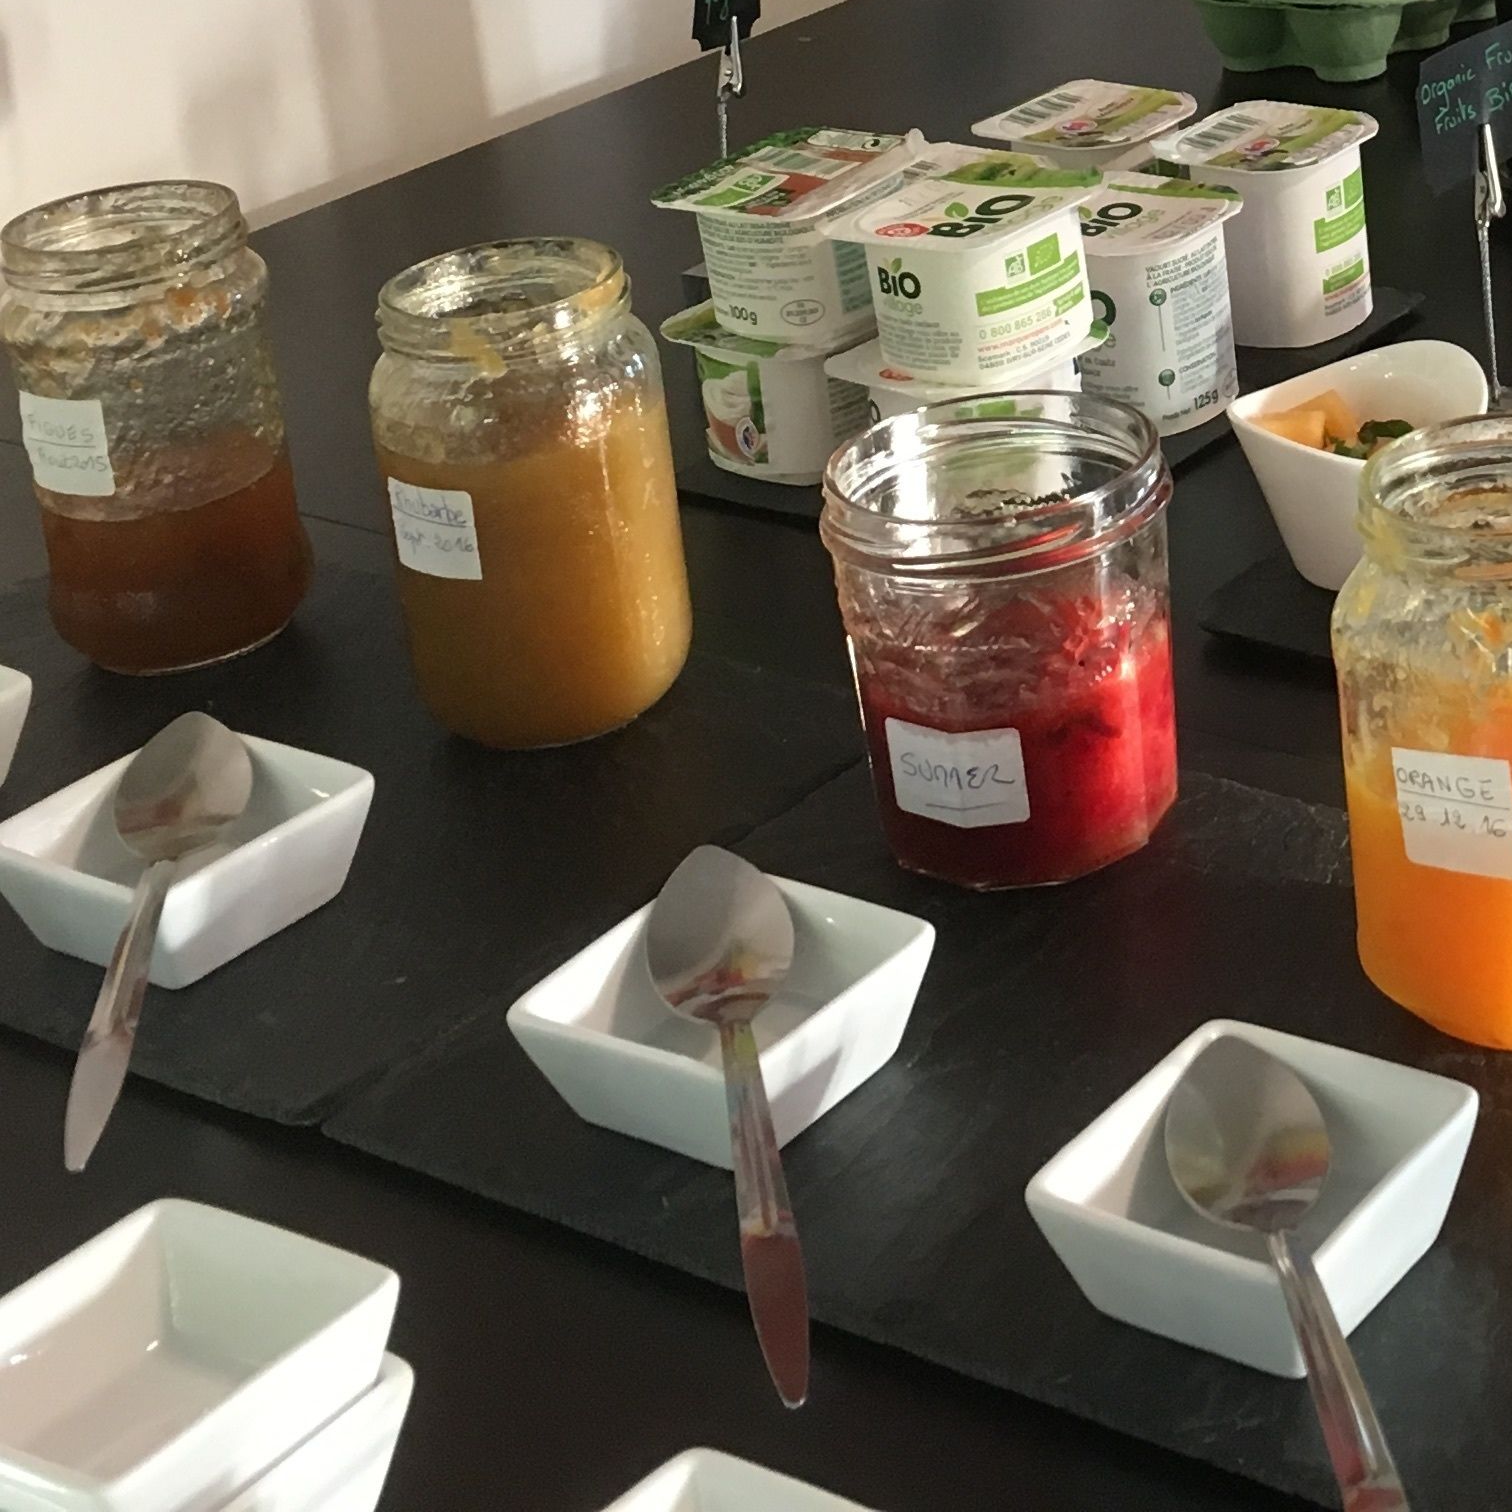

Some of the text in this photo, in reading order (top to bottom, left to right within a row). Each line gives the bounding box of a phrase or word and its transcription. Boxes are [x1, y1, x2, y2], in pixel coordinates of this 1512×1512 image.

[1420, 64, 1476, 111] Organic
[1435, 98, 1476, 135] Fruits
[927, 194, 1036, 238] BIO
[878, 266, 921, 299] BIO
[1396, 767, 1495, 802] ORANGE
